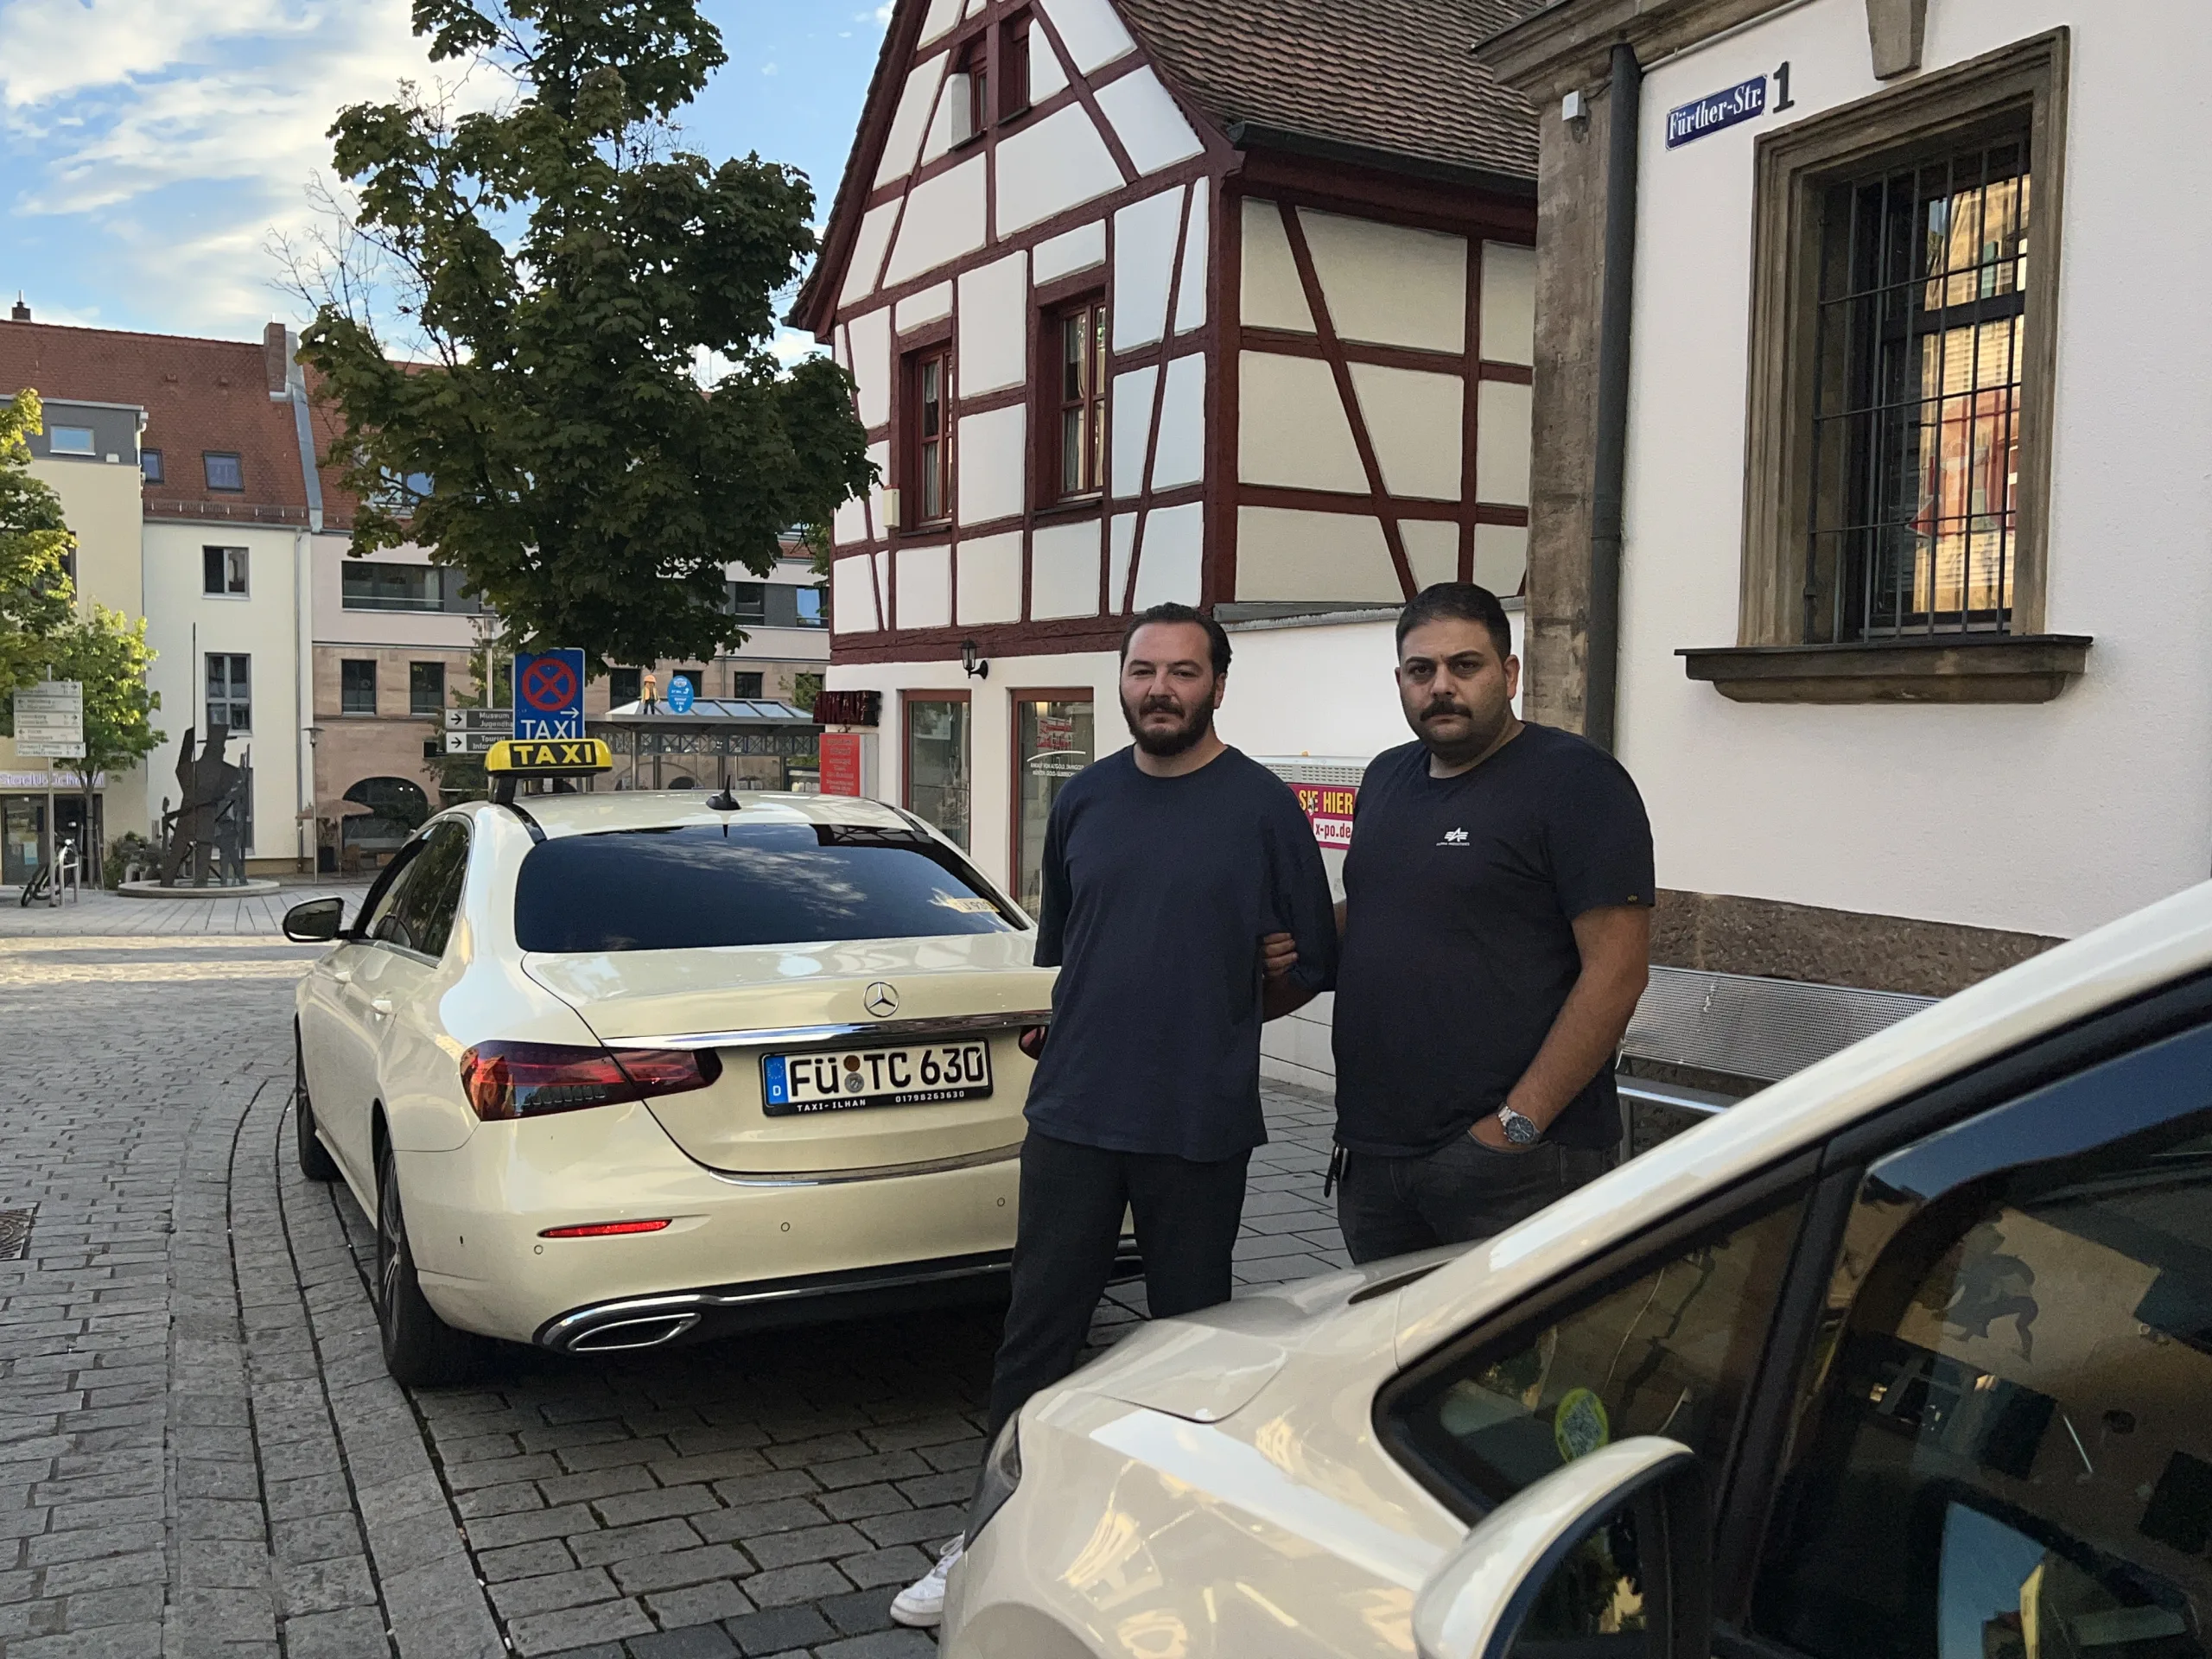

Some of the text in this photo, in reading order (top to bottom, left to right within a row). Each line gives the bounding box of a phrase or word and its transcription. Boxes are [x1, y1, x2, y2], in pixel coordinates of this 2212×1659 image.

[1772, 60, 1796, 114] 1
[1668, 84, 1763, 141] Fürther-Str.
[520, 719, 576, 740] TAXI
[512, 743, 593, 765] TAXI
[1299, 790, 1353, 815] SIE HIER
[1315, 823, 1351, 840] x-po.de
[789, 1046, 985, 1097] FÜ TC 630
[772, 1085, 782, 1097] D
